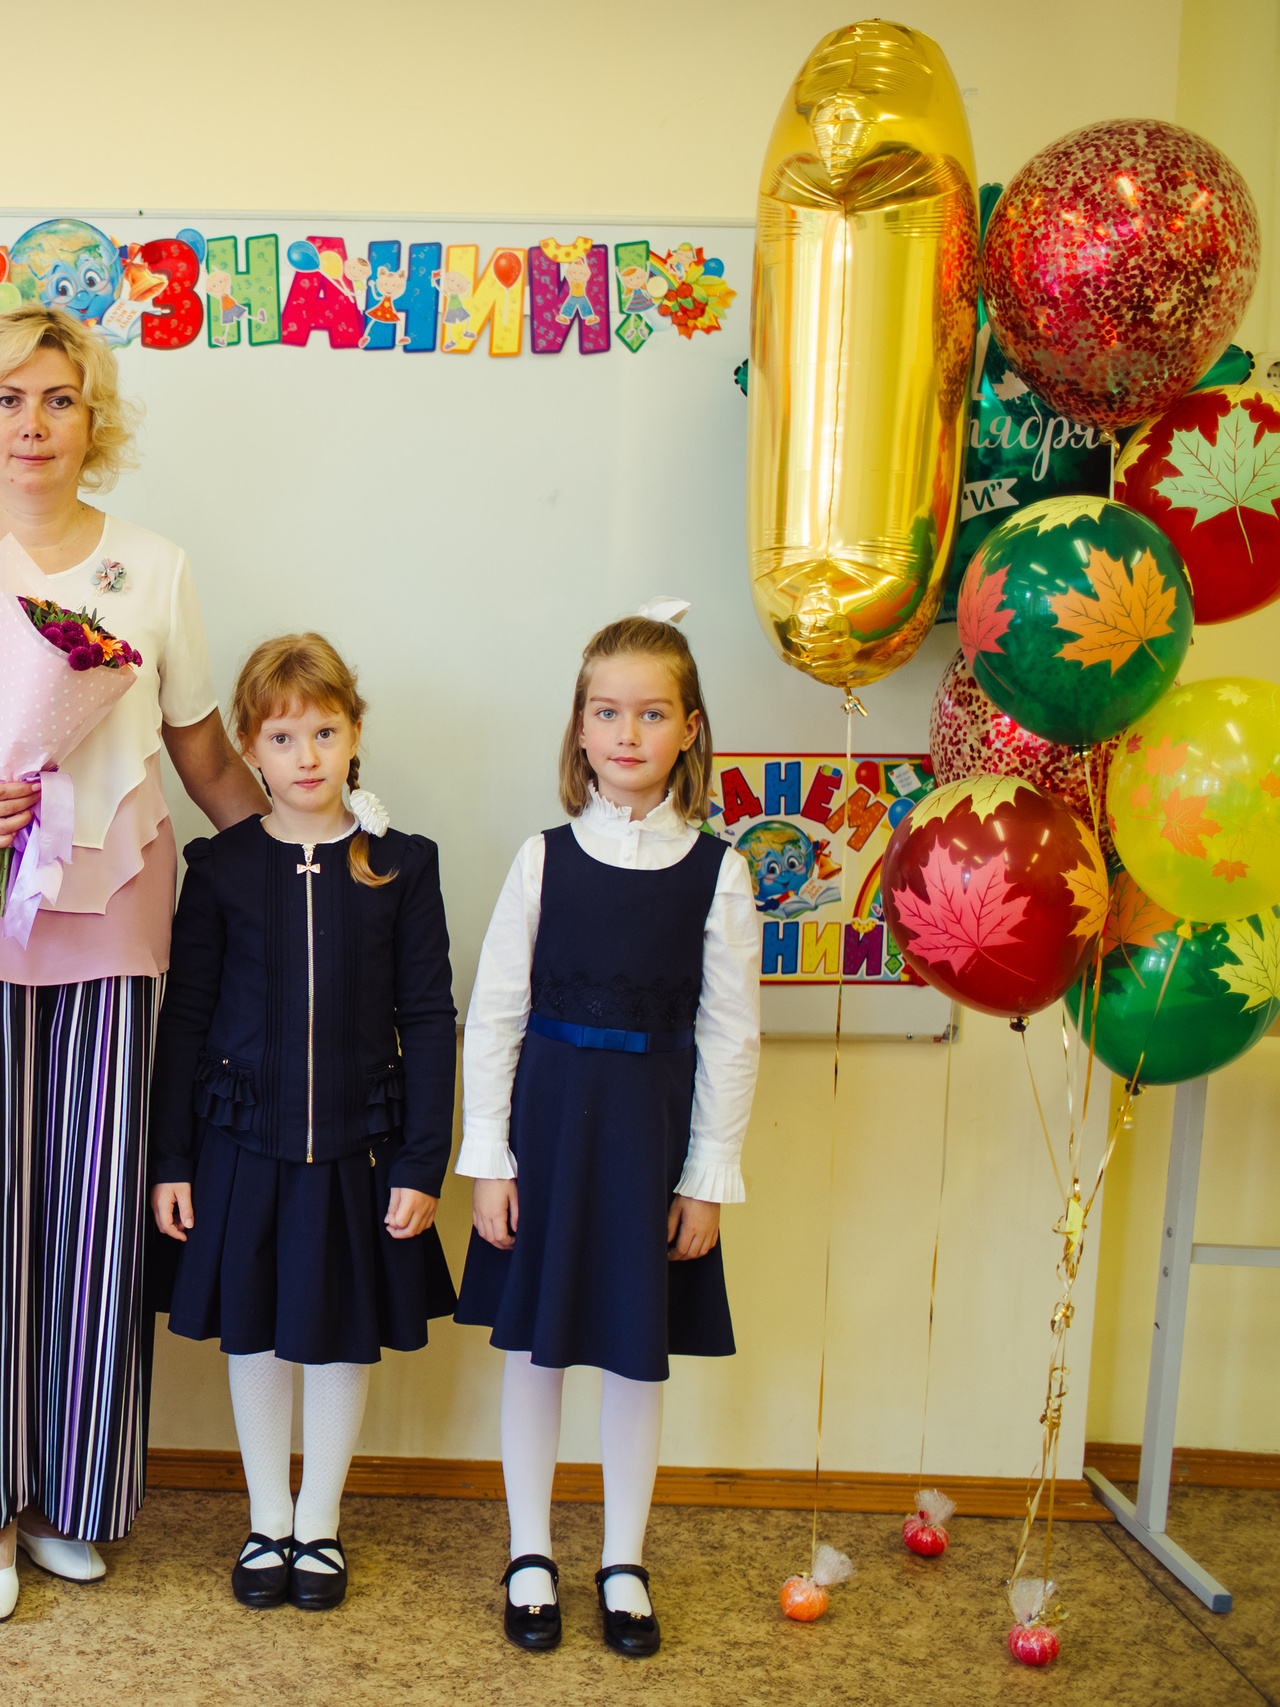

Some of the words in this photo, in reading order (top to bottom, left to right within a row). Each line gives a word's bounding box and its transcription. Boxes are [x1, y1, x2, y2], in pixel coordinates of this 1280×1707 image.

[140, 233, 654, 358] ЗНАНИЙ!
[720, 761, 888, 852] ДНЕМ
[761, 918, 903, 977] НИЙ!
